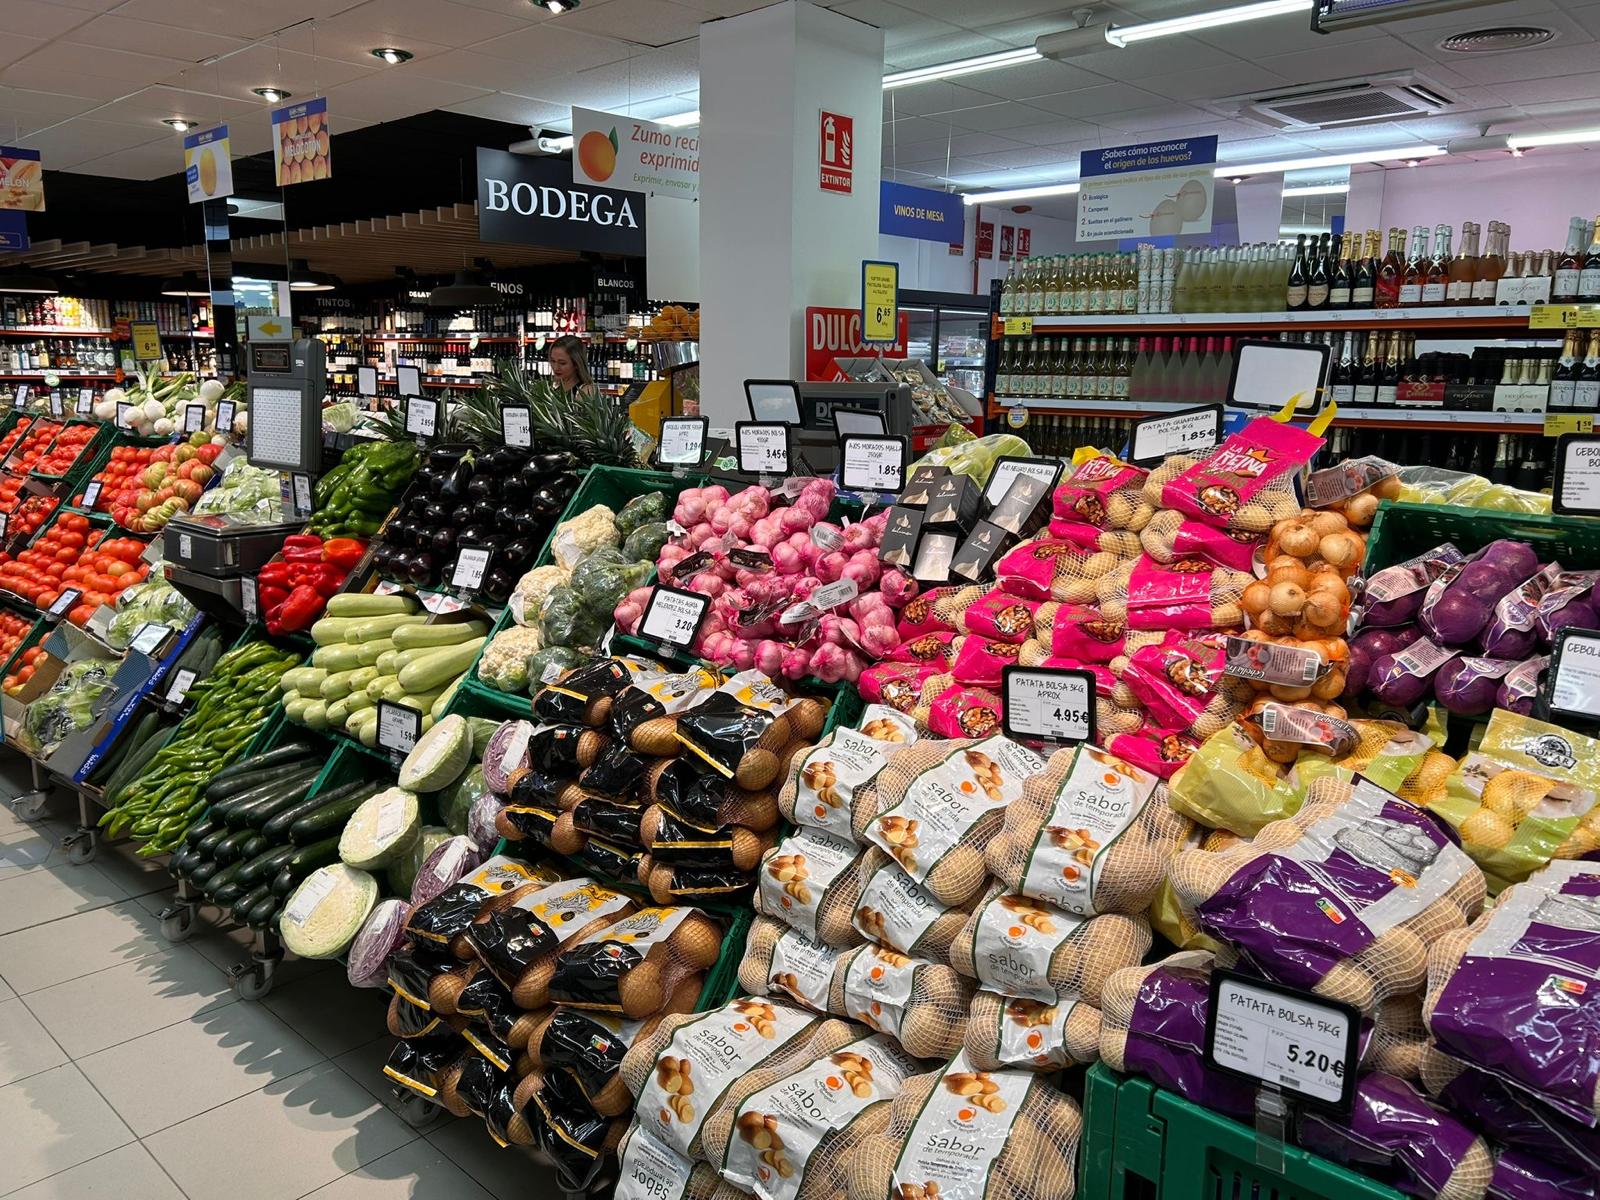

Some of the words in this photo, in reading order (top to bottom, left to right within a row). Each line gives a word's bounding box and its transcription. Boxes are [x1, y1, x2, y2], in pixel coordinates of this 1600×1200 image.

[631, 124, 671, 147] Zumo
[1101, 146, 1127, 162] ¿Sabes
[1127, 145, 1149, 156] cómo
[1149, 141, 1189, 154] reconocer
[1104, 161, 1112, 170] el
[1112, 157, 1136, 171] origen
[1137, 156, 1147, 166] de
[1147, 155, 1160, 165] los
[1160, 150, 1193, 164] huevos?
[821, 172, 851, 187] EXTINTOR
[484, 177, 639, 229] BODEGA
[894, 204, 915, 218] VINOS
[915, 208, 925, 220] DE
[926, 210, 945, 223] MESA
[597, 278, 635, 289] BLANCOS
[316, 297, 351, 308] TINTOS
[1142, 420, 1172, 431] PATATA
[1158, 425, 1181, 434] BOLSA
[1182, 428, 1217, 442] 1.85€
[766, 448, 787, 459] 3.45€
[1228, 443, 1244, 454] LA
[878, 464, 902, 476] 1.85€
[1208, 449, 1268, 477] REINA
[674, 618, 697, 632] 3.20€
[1015, 677, 1045, 689] PATATA
[1045, 680, 1068, 691] BOLSA
[1068, 683, 1085, 694] 3KG
[1036, 690, 1062, 700] APROX
[1053, 707, 1089, 724] 4.95€
[843, 736, 881, 757] sabor
[927, 781, 970, 815] sabor
[1077, 789, 1130, 814] sabor
[1073, 799, 1086, 808] de
[1086, 802, 1127, 819] temporada
[808, 834, 850, 853] sabor
[886, 878, 896, 889] de
[892, 871, 936, 911] sabor
[989, 950, 1036, 978] sabor
[1229, 993, 1276, 1017] PATATA
[1277, 1008, 1315, 1029] BOLSA
[1317, 1020, 1341, 1039] 5KG
[699, 1028, 742, 1063] sabor
[700, 1038, 732, 1071] temporada
[1286, 1044, 1345, 1079] 5.20€
[787, 1082, 831, 1123] sabor
[922, 1146, 933, 1154] de
[934, 1147, 979, 1161] temporada
[927, 1134, 986, 1156] sabor
[633, 1158, 666, 1183] temporada
[664, 1178, 674, 1188] de
[631, 1168, 670, 1200] sabor
